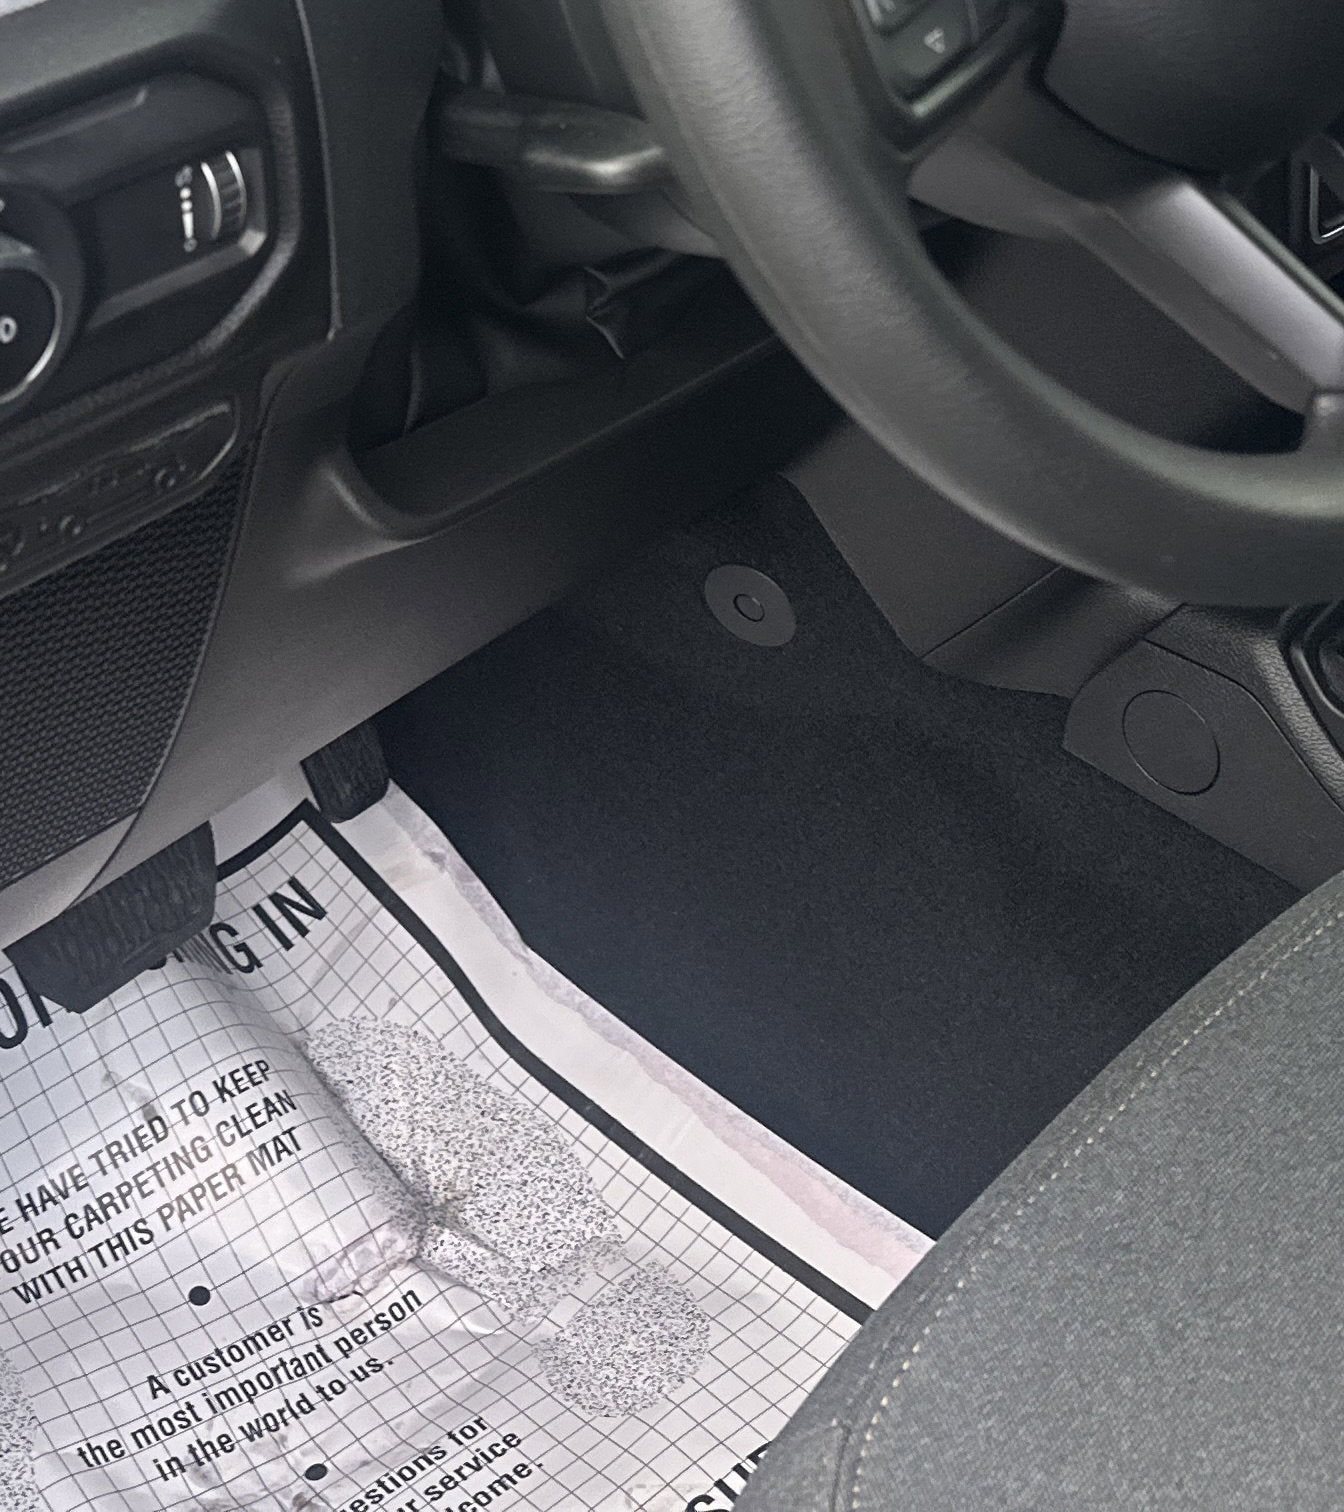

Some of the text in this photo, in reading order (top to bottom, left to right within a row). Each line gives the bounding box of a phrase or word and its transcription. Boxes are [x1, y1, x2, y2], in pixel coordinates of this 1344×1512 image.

[253, 876, 328, 951] IN
[16, 1164, 89, 1222] HAVE
[89, 1115, 170, 1176] TRIED
[170, 1090, 209, 1126] TO
[212, 1059, 270, 1104] KEEP
[65, 1134, 212, 1239] CARPETING
[215, 1090, 297, 1147] CLEAN
[12, 1126, 303, 1303] WITH THIS PAPER MAT
[77, 1289, 423, 1468] the most important person
[146, 1304, 324, 1399] A customer is
[154, 1358, 395, 1482] in the world to us.
[339, 1416, 489, 1512] estions for
[424, 1432, 522, 1501] service
